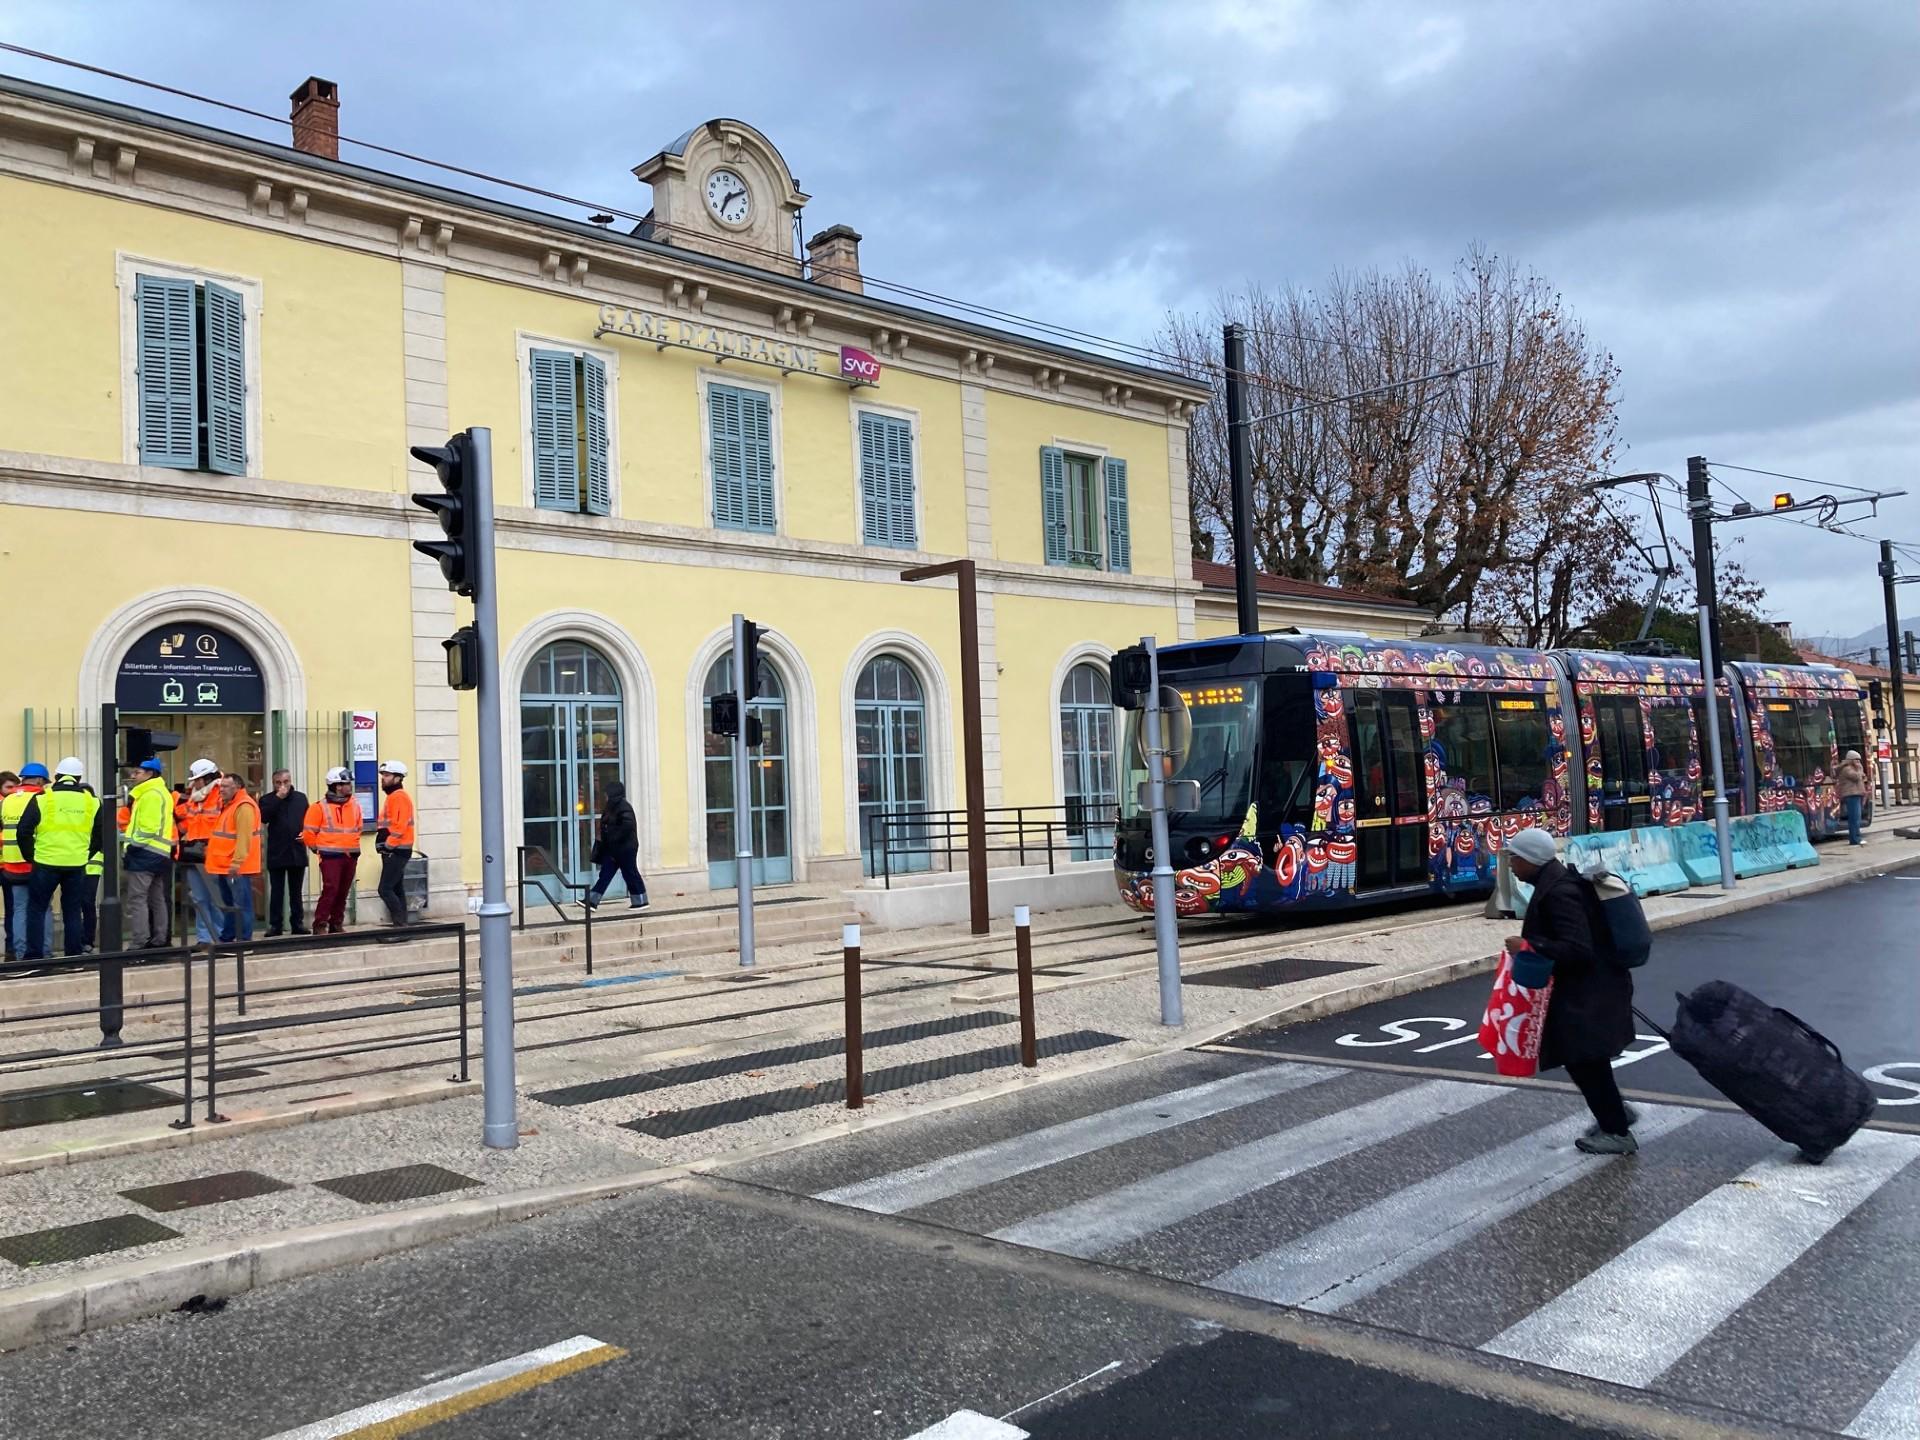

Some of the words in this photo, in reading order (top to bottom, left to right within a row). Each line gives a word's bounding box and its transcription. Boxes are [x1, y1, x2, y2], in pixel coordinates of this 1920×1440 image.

[598, 304, 668, 337] GARE
[680, 320, 818, 370] D'AUBAGNE
[843, 358, 880, 375] SNCF
[163, 663, 201, 671] Information
[202, 664, 233, 672] Tramways
